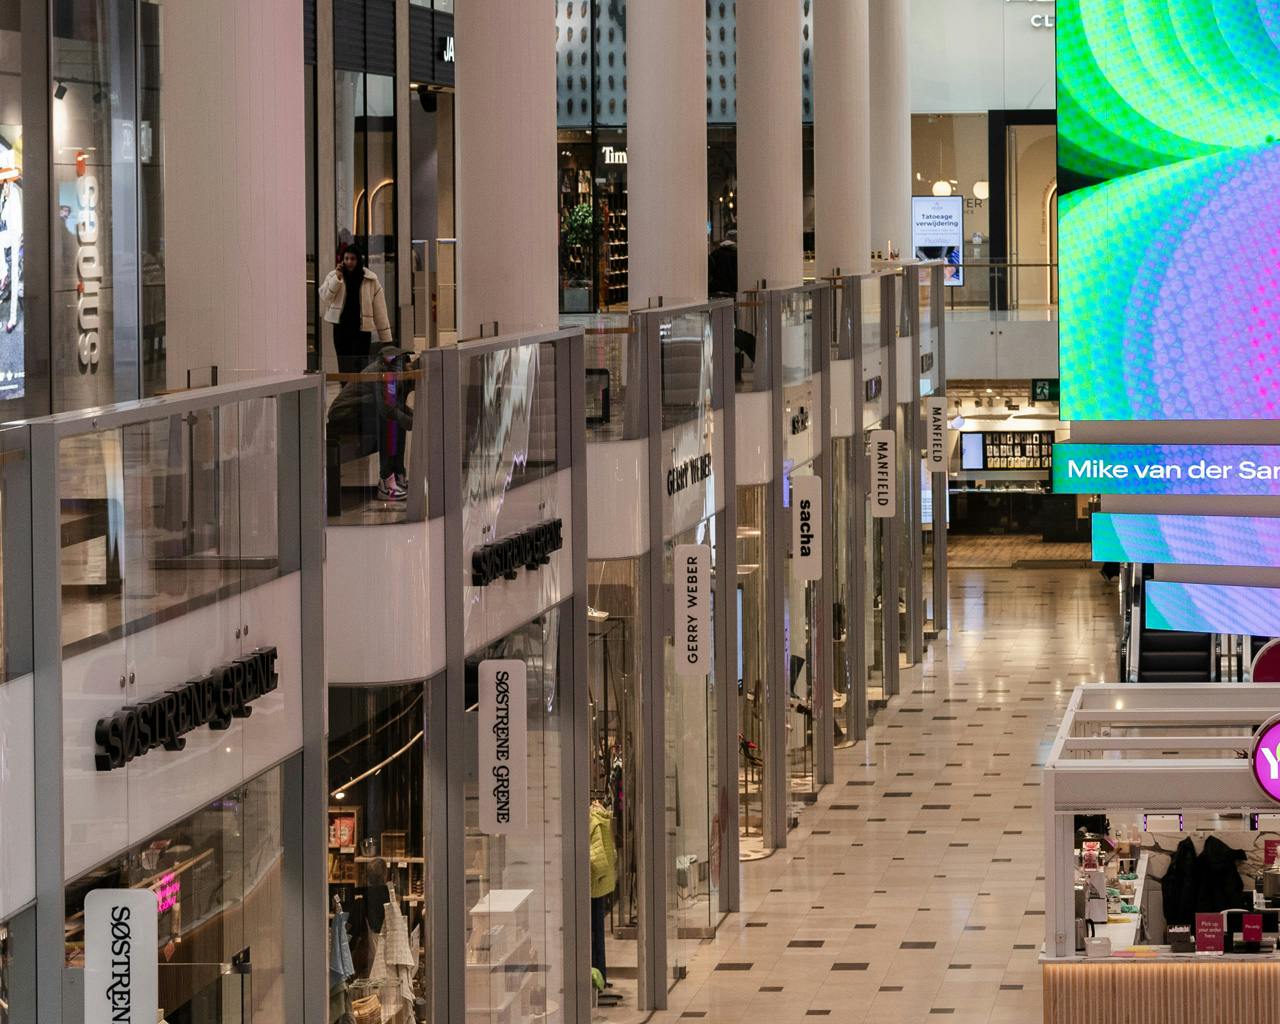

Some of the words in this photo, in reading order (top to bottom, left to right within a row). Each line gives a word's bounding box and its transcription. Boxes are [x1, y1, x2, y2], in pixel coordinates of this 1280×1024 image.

[602, 146, 627, 164] Tim
[932, 407, 943, 463] MANFIELD
[877, 441, 889, 506] MANFIELD
[1068, 459, 1129, 479] Mike
[1134, 463, 1182, 479] van
[1187, 460, 1233, 479] der
[800, 499, 814, 557] sacha
[687, 556, 698, 608] WEBER
[687, 615, 698, 664] GERRY
[493, 670, 510, 761] SØSTRENE
[493, 765, 510, 824] GRENE
[106, 906, 131, 1024] SØSTREN
